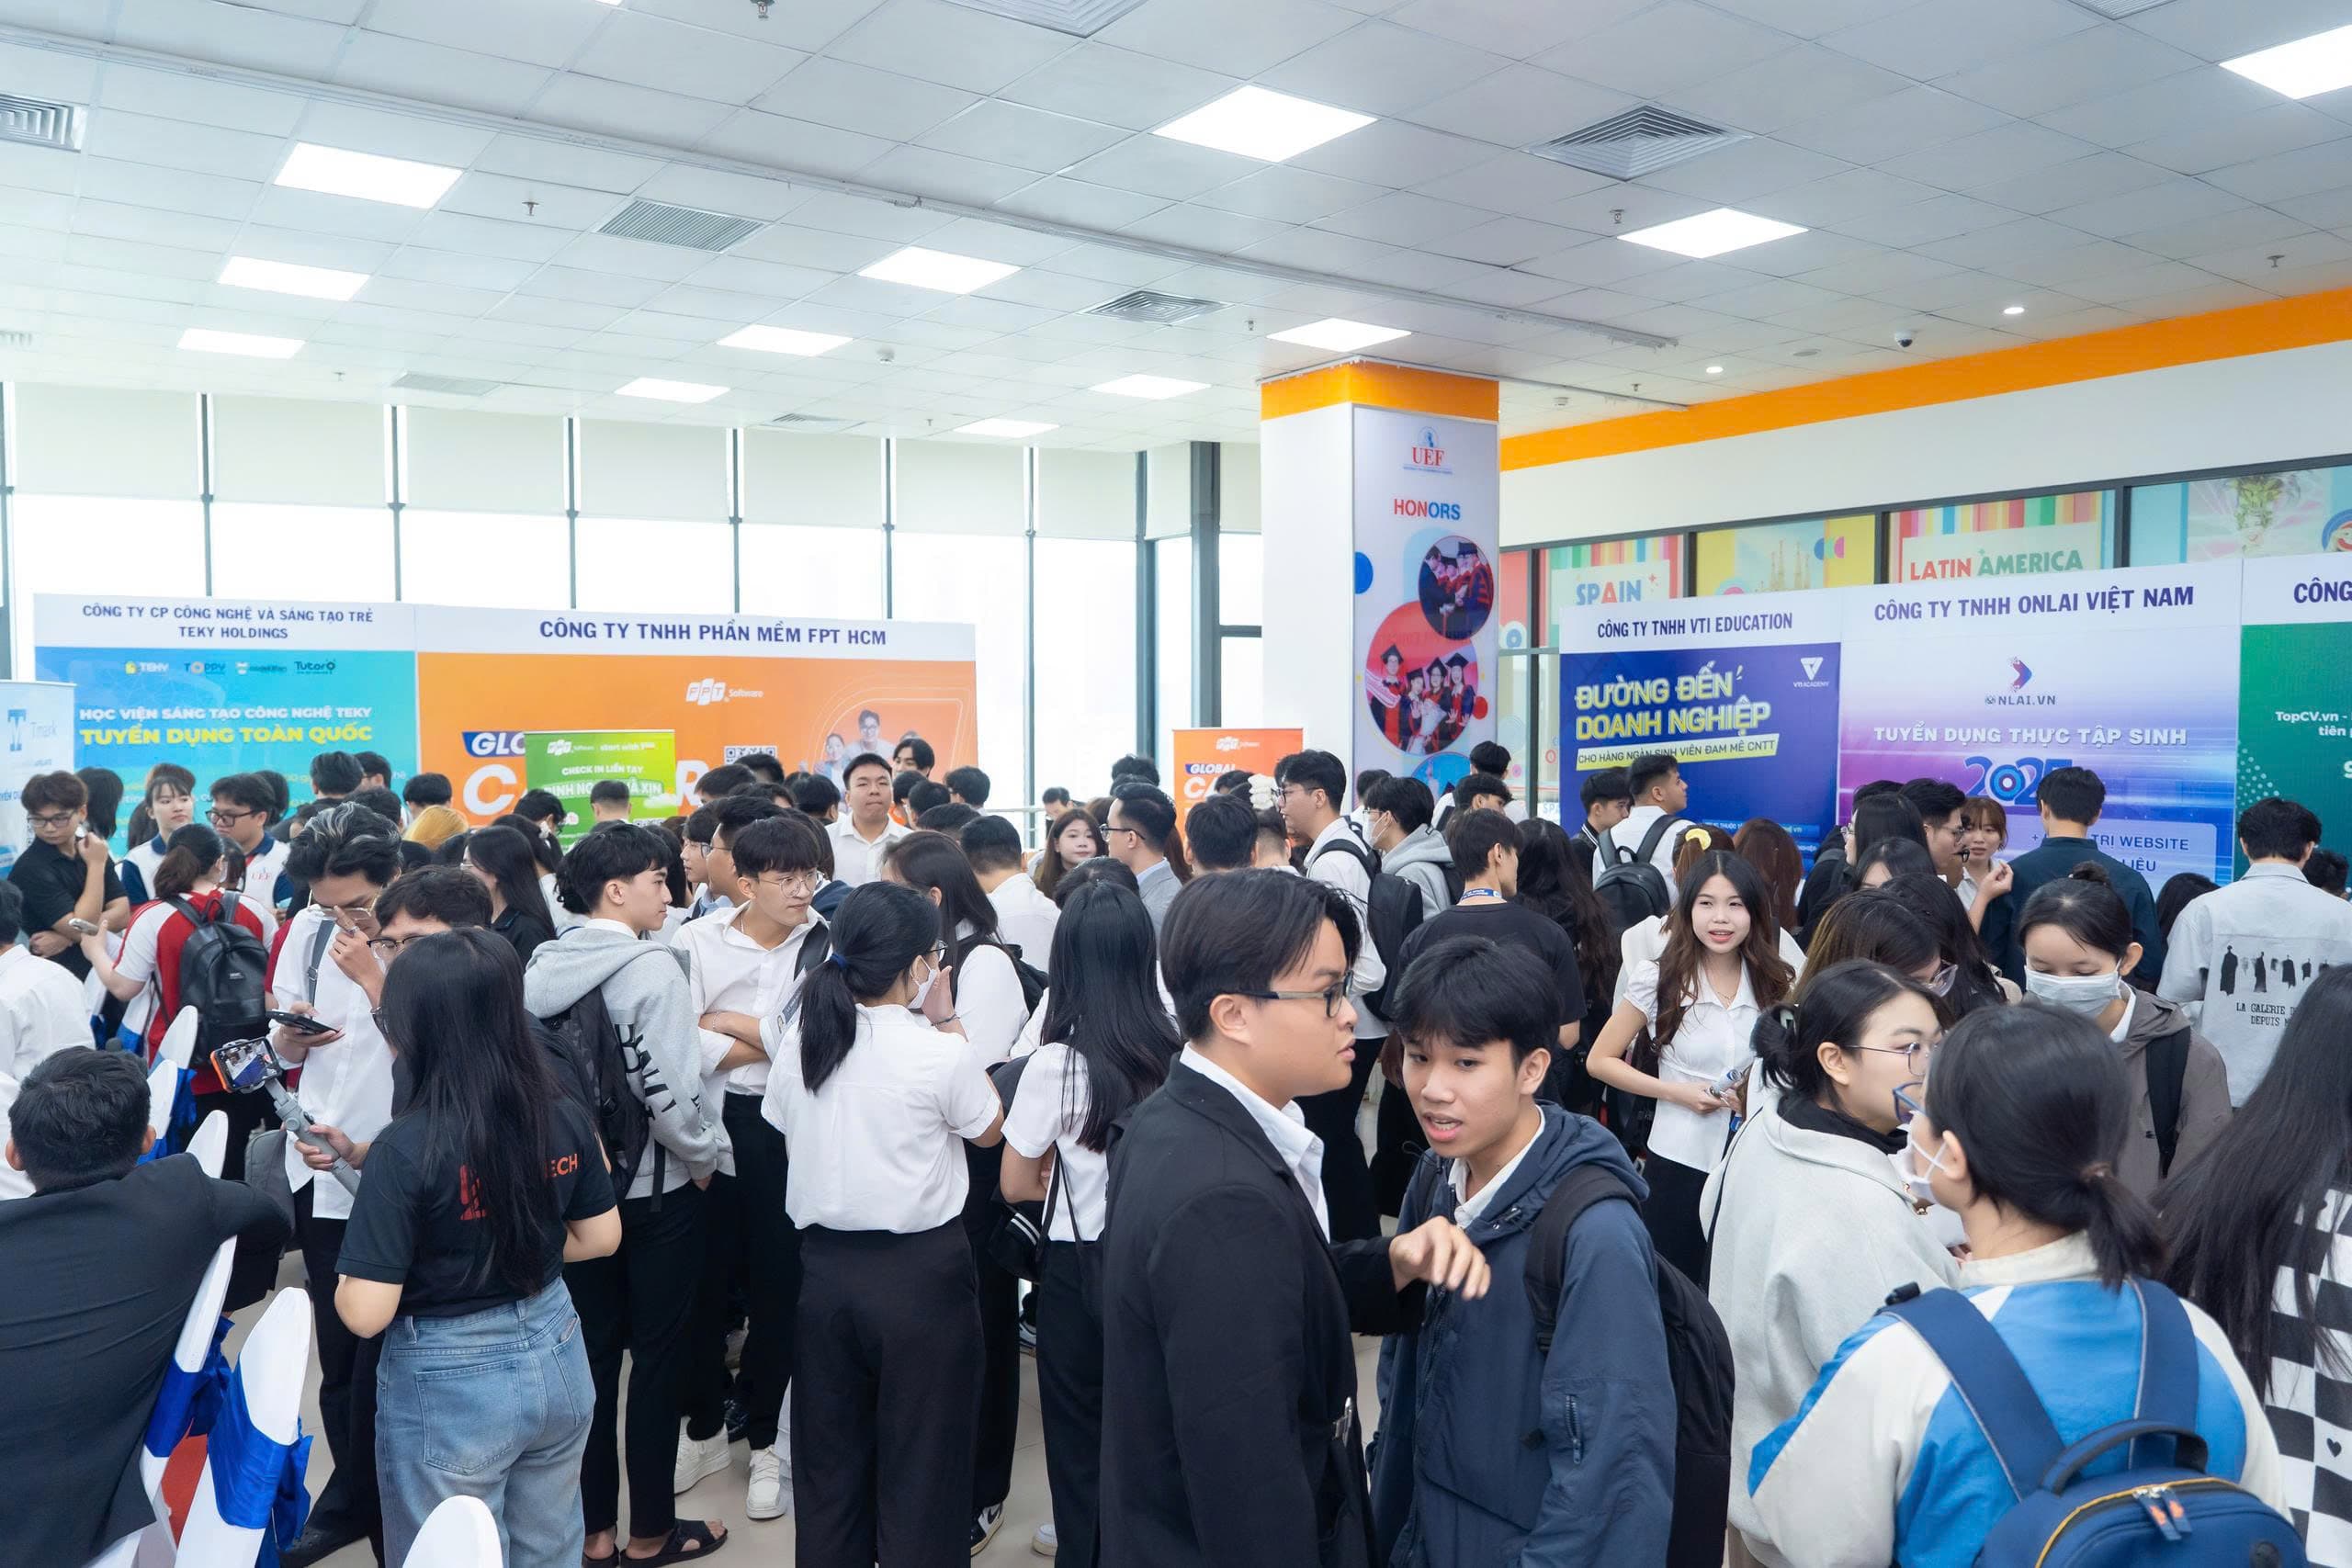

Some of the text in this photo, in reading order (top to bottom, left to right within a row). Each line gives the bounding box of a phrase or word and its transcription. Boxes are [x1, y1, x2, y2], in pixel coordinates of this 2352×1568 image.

[1412, 446, 1445, 467] UEF
[1394, 498, 1461, 521] HONORS
[1910, 549, 2084, 581] LATIN AMERICA
[1576, 580, 1642, 605] SPAIN
[2293, 577, 2352, 604] CÔNG
[83, 603, 374, 625] CÔNG TY CP CÔNG NGHỆ VÀ SÁNG TẠO TRẺ
[1874, 585, 2194, 621] CÔNG TY TNHH ONLAI VIỆT NAM
[179, 626, 288, 639] TEKY HOLDINGS
[540, 617, 887, 645] CÔNG TY TNHH PHẦN MỀM FPT HCM
[1597, 612, 1792, 638] CÔNG TY TNHH VTI EDUCATION
[685, 678, 764, 705] FPT Software
[1575, 660, 1734, 710] ĐƯỜNG ĐẾN
[79, 705, 372, 724] HỌC VIỆN SÁNG TẠO CÔNG NGHỆ TEKY
[1576, 694, 1771, 740] DOANH NGHIỆP
[2275, 711, 2339, 724] TopCV.vn
[79, 722, 373, 748] TUYỂN DỤNG TOÀN QUỐC
[1874, 720, 2188, 749] TUYỂN DỤNG THỰC TẬP SINH
[2318, 726, 2346, 736] tiên
[1578, 753, 1597, 764] CHO
[1599, 750, 1624, 762] HÀNG
[1679, 744, 1702, 757] VIÊN
[1705, 744, 1728, 755] ĐAM
[1730, 740, 1746, 753] MÊ
[1747, 740, 1775, 751] CNTT
[561, 766, 594, 775] CHECK
[594, 764, 605, 773] IN
[627, 764, 644, 773] TAY
[2120, 836, 2189, 851] WEBSITE
[2236, 1002, 2246, 1012] LA
[2251, 1003, 2286, 1015] GALERIE
[2251, 1016, 2280, 1027] DEPUIS
